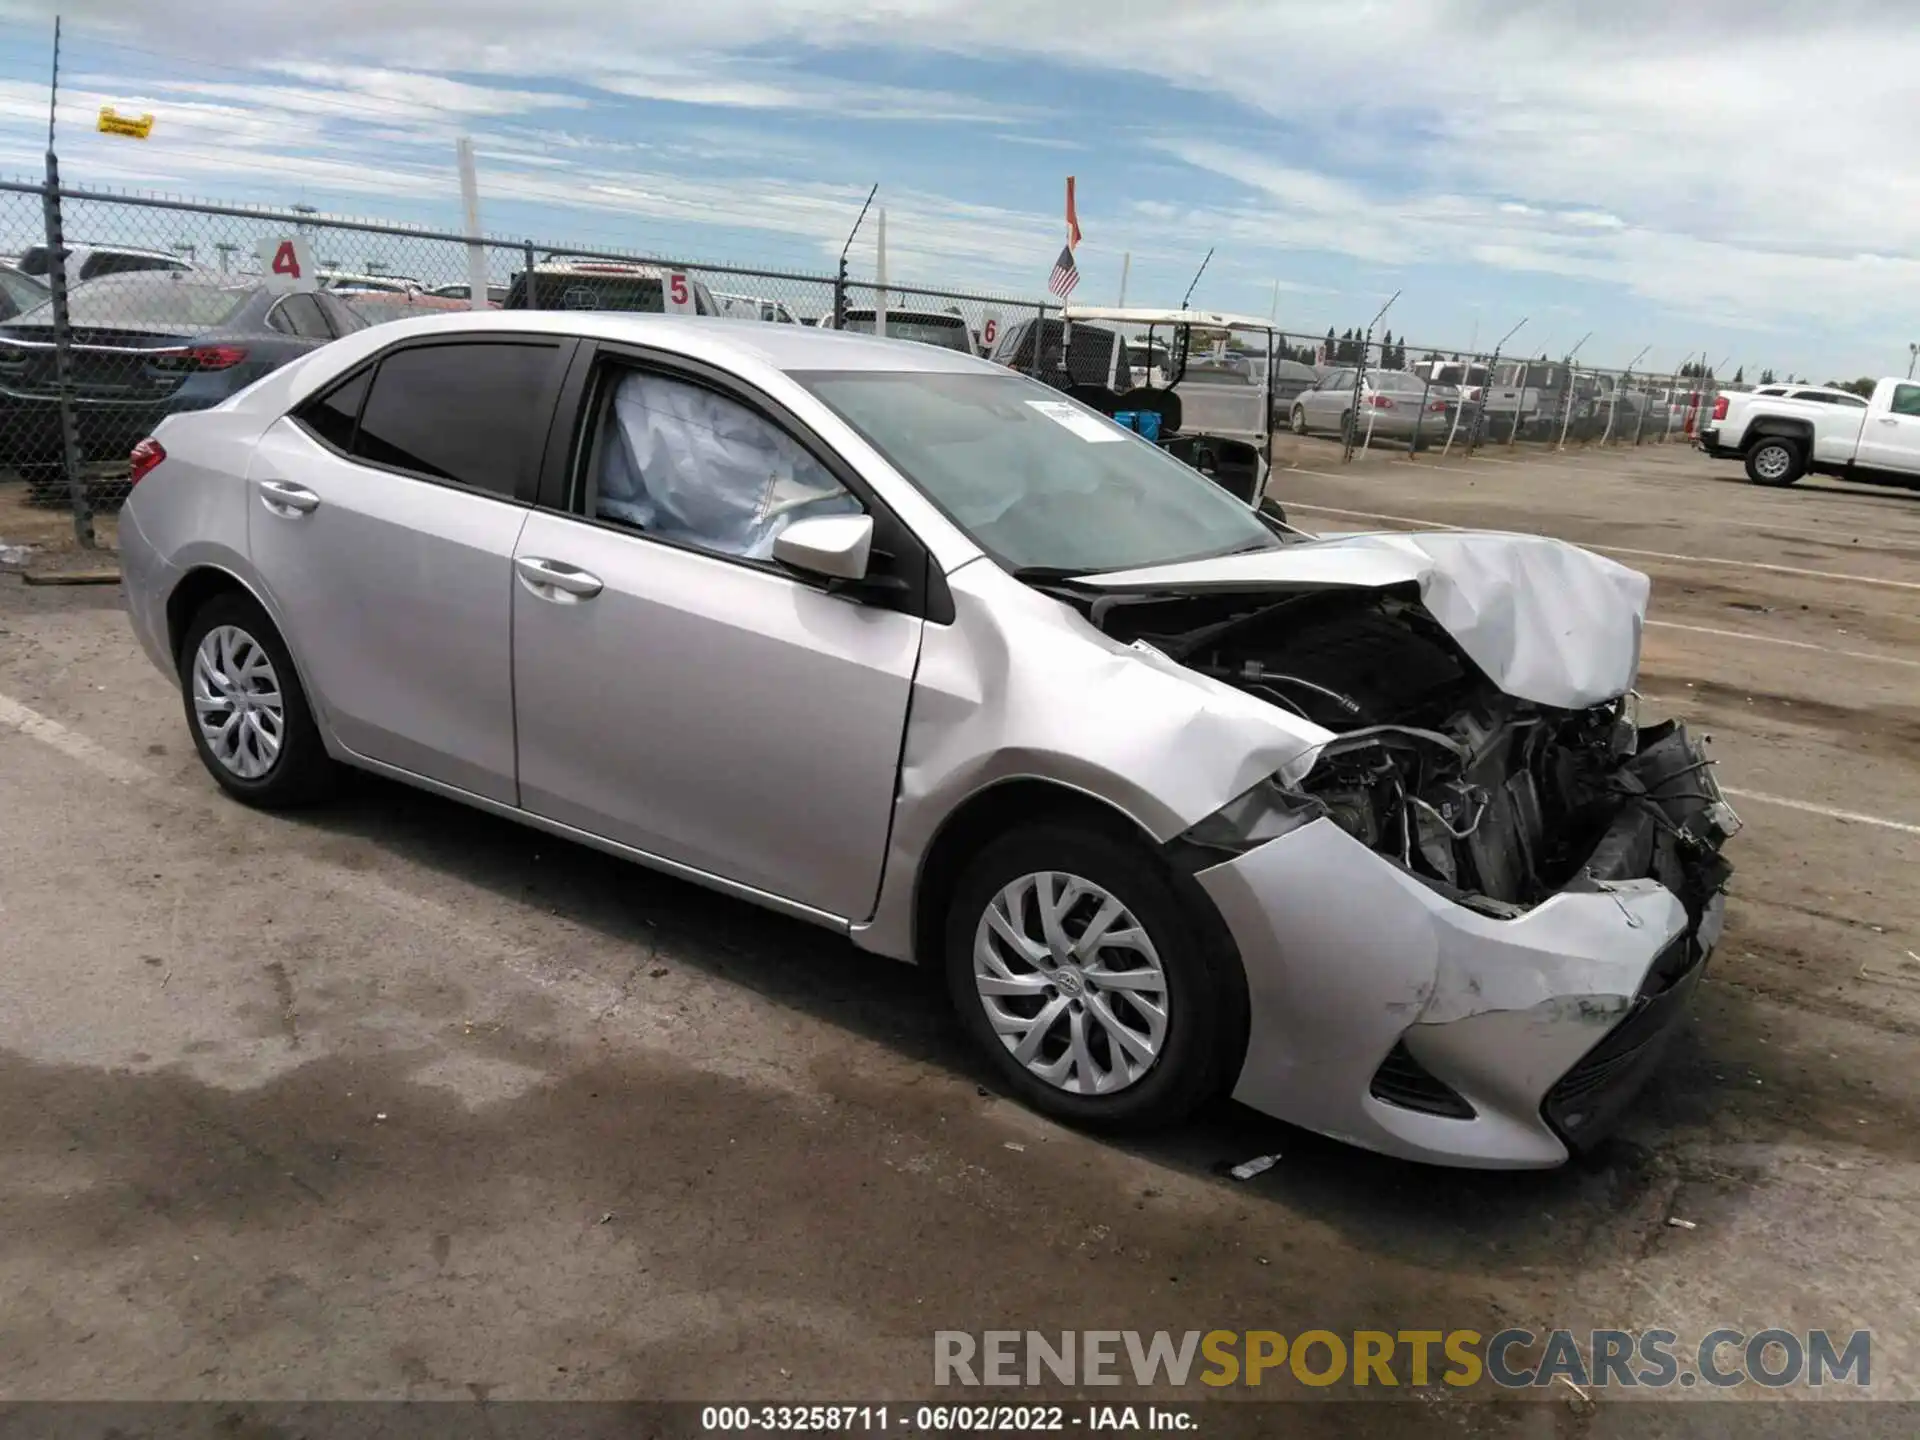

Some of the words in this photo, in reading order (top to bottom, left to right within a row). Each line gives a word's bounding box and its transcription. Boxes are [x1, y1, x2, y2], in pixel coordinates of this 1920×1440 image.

[272, 240, 300, 280] 4
[671, 274, 689, 305] 5
[985, 319, 996, 343] 6
